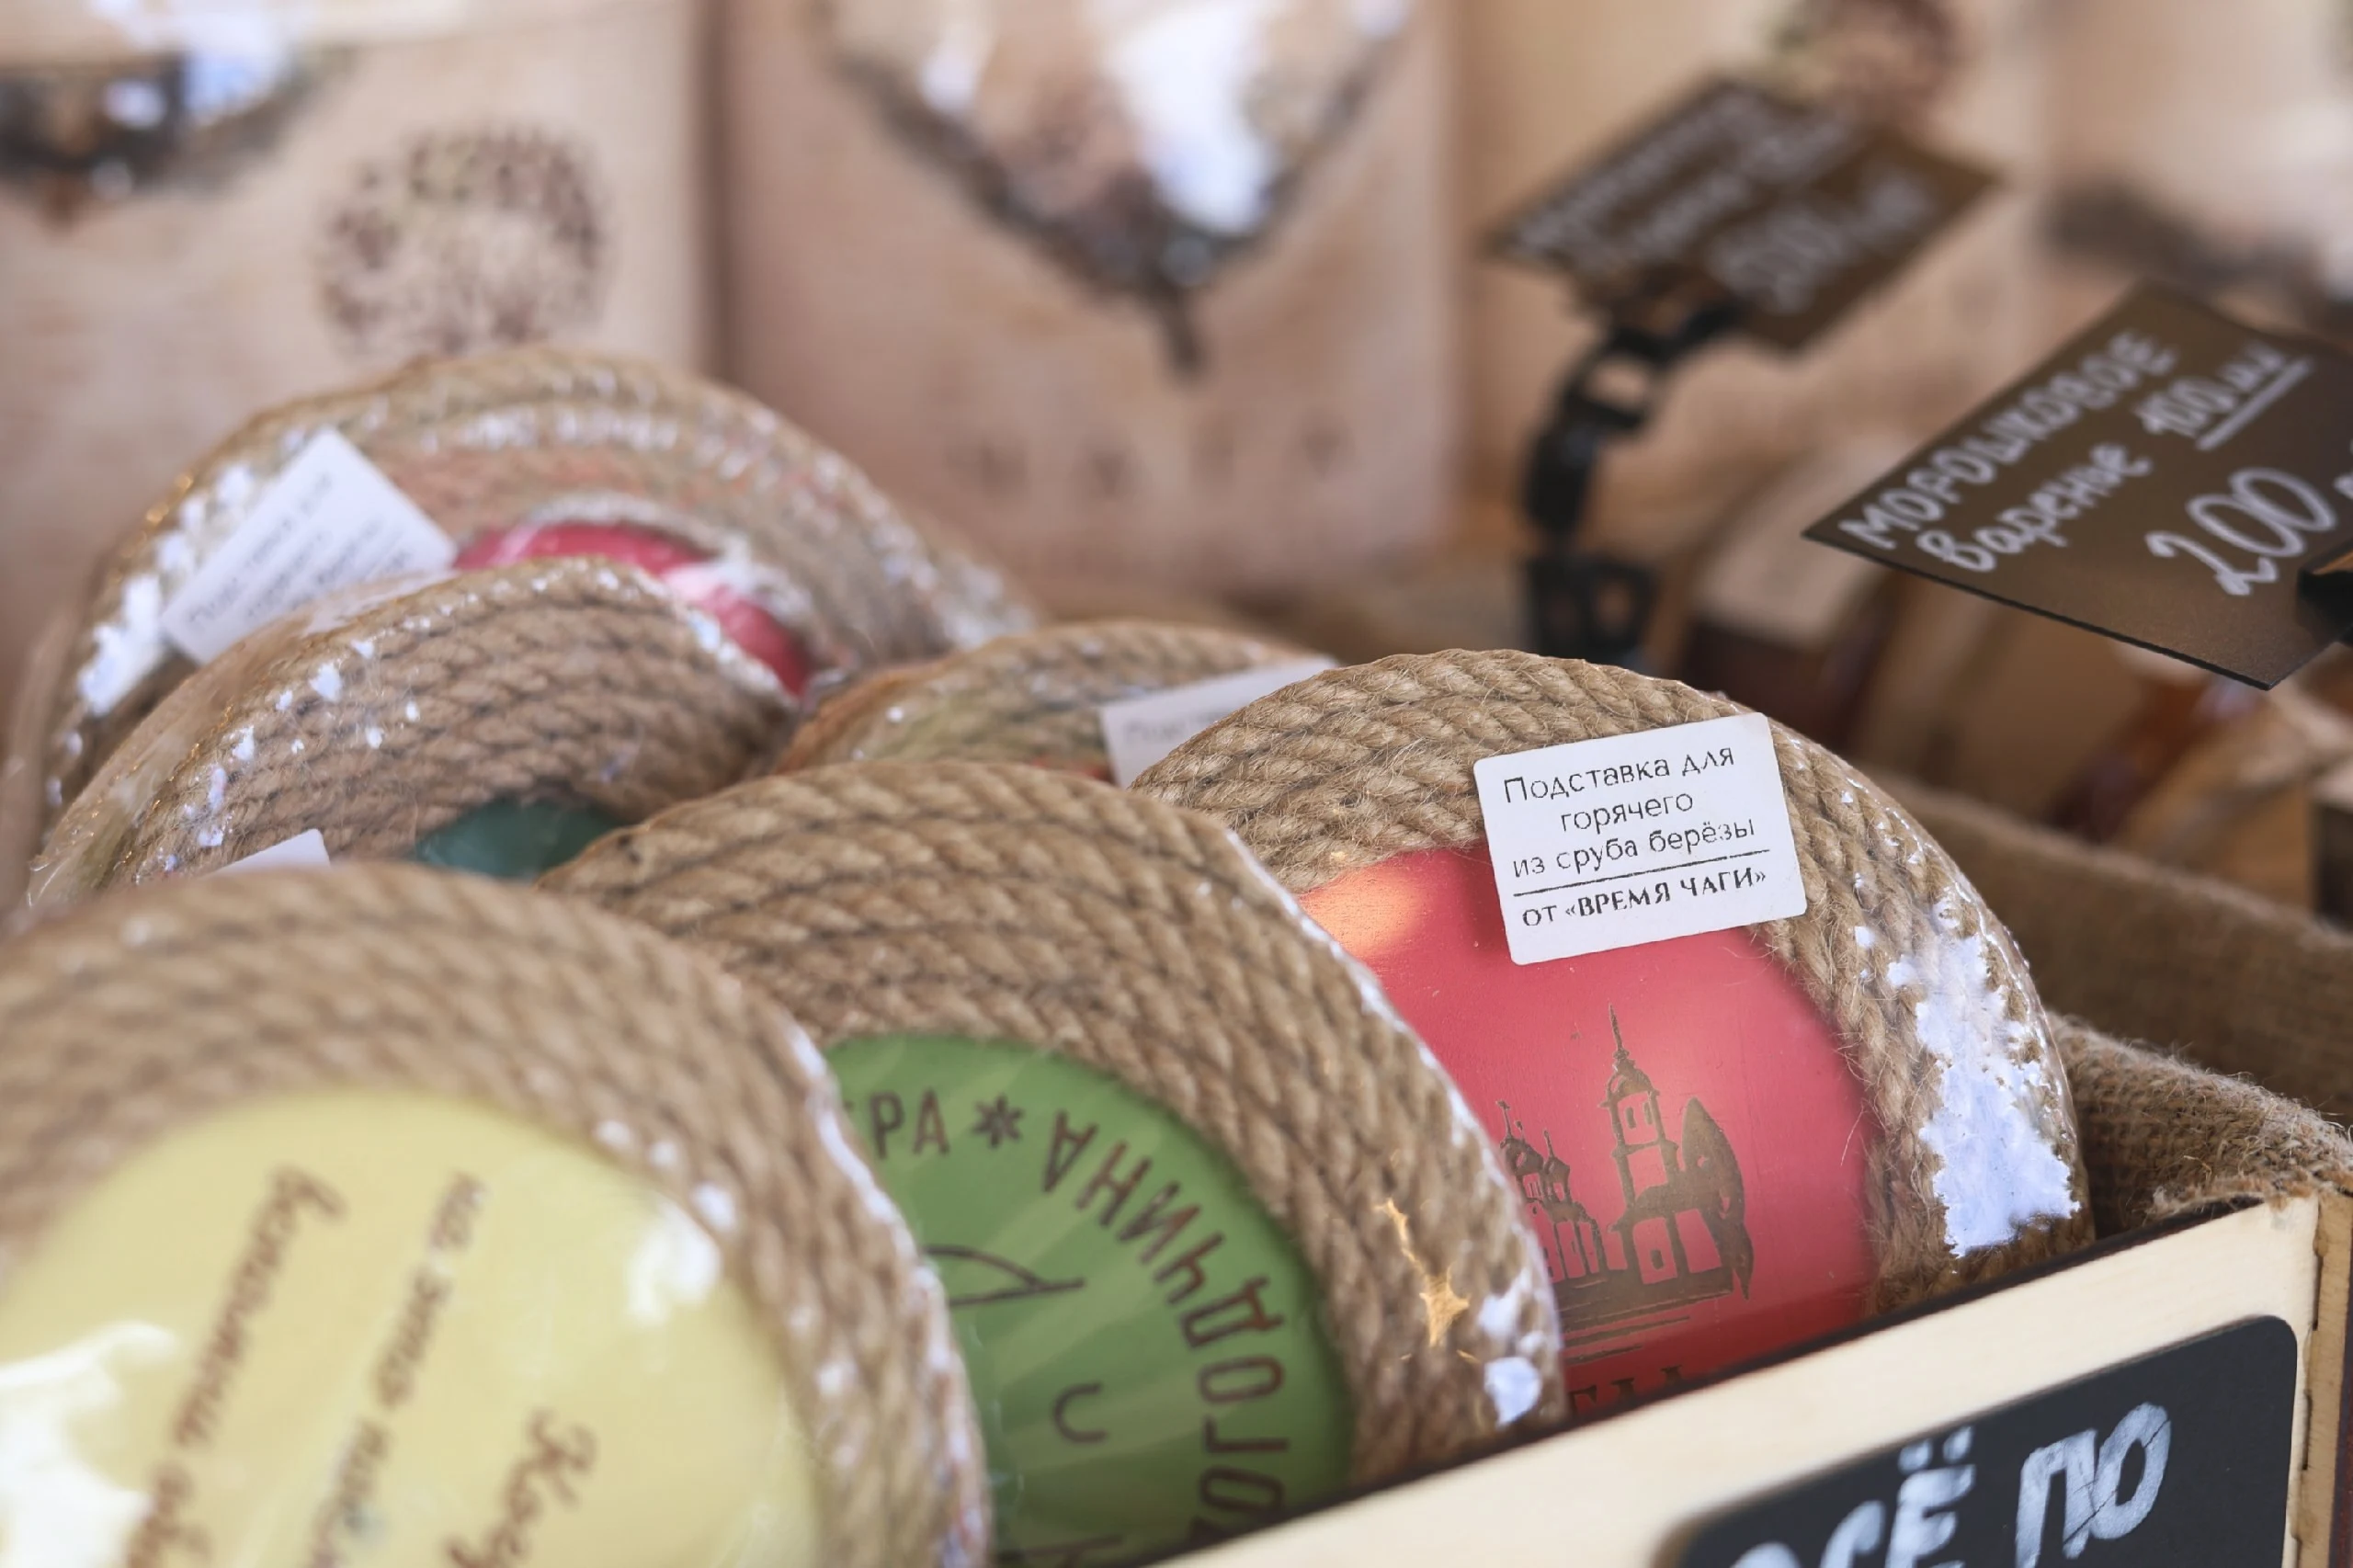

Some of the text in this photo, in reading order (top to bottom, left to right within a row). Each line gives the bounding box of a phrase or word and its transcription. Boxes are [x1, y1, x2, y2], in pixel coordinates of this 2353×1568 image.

[2143, 466, 2336, 596] 200
[1503, 746, 1736, 804] Подставка для
[1560, 791, 1694, 835] горячего
[1512, 818, 1756, 879] из сруба берёзы
[1564, 881, 1671, 918] «ВРЕМЯ
[1680, 867, 1768, 898] ЧАГИ»
[843, 1086, 951, 1162] РА
[1041, 1108, 1290, 1542] ОГОДЧИНА
[1728, 1401, 2172, 1568] СЁ ПО
